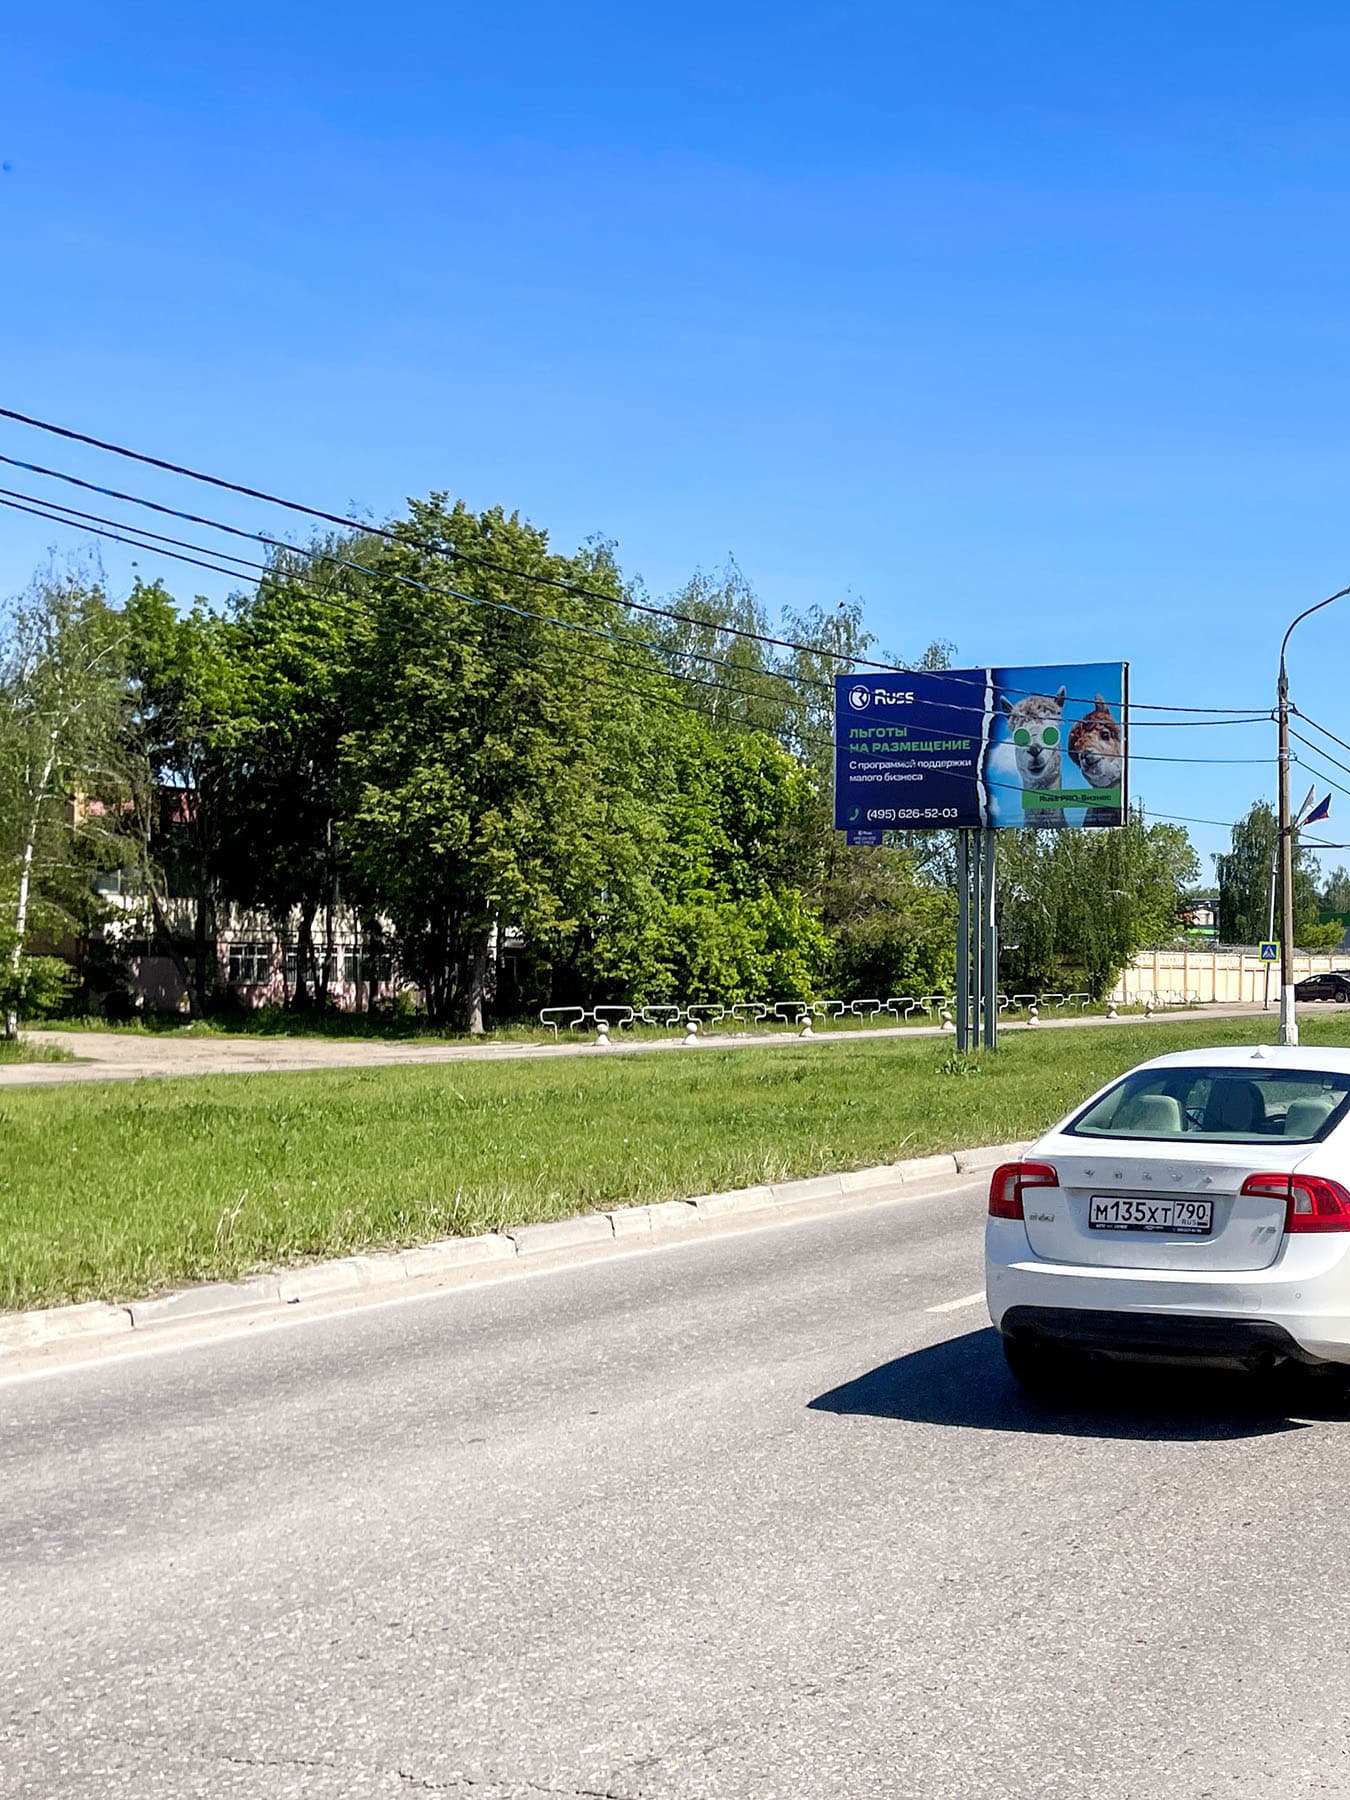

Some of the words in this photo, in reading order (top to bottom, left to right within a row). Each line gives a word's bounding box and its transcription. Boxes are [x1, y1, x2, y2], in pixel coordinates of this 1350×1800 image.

[849, 727, 907, 738] ЛЬГОТЫ
[849, 742, 869, 752] НА
[872, 740, 971, 752] РАЗМЕЩЕНИЕ
[849, 761, 858, 769] С
[858, 759, 916, 771] программой
[918, 759, 972, 769] поддержки
[849, 774, 883, 782] малого
[884, 772, 923, 781] бизнеса
[866, 809, 896, 821] (495)
[898, 808, 958, 819] 626-52-03
[1176, 1203, 1206, 1220] 790
[1182, 1218, 1197, 1226] RUS
